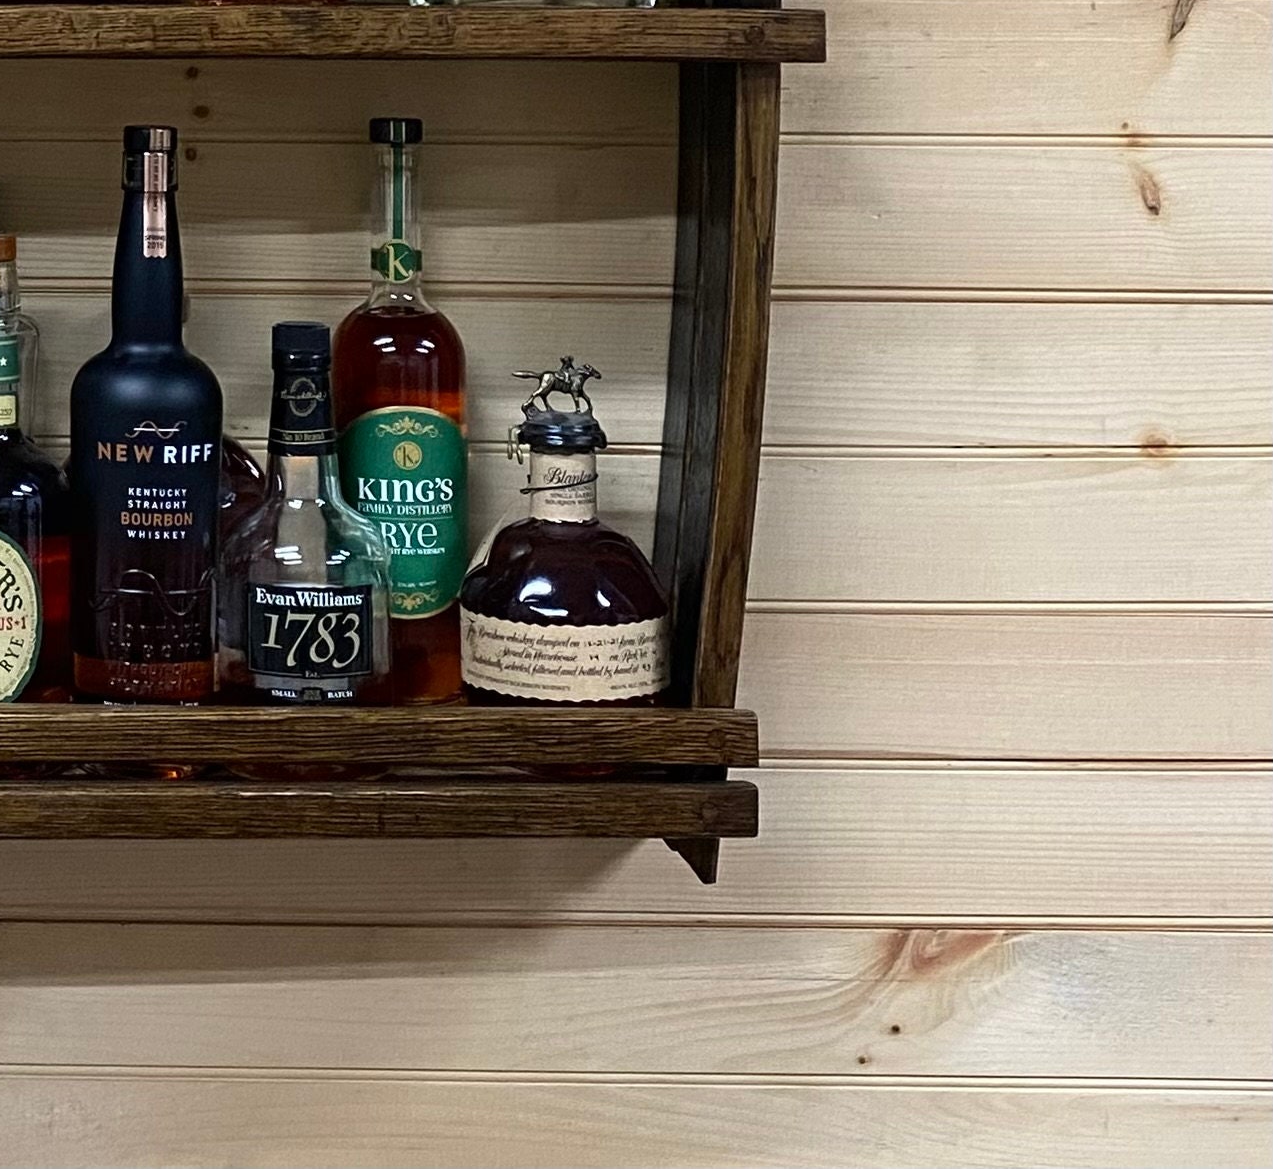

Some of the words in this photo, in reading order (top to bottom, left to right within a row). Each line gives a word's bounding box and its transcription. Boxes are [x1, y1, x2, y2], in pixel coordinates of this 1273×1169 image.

[97, 441, 155, 463] NEW
[163, 443, 214, 464] RIFF
[128, 487, 188, 498] KENTUCKY
[128, 499, 188, 510] STRAIGHT
[120, 511, 194, 527] BOURBON
[127, 530, 187, 540] WHISKEY
[255, 586, 297, 607] Evan
[296, 590, 364, 608] Williams
[260, 609, 361, 670] 1783
